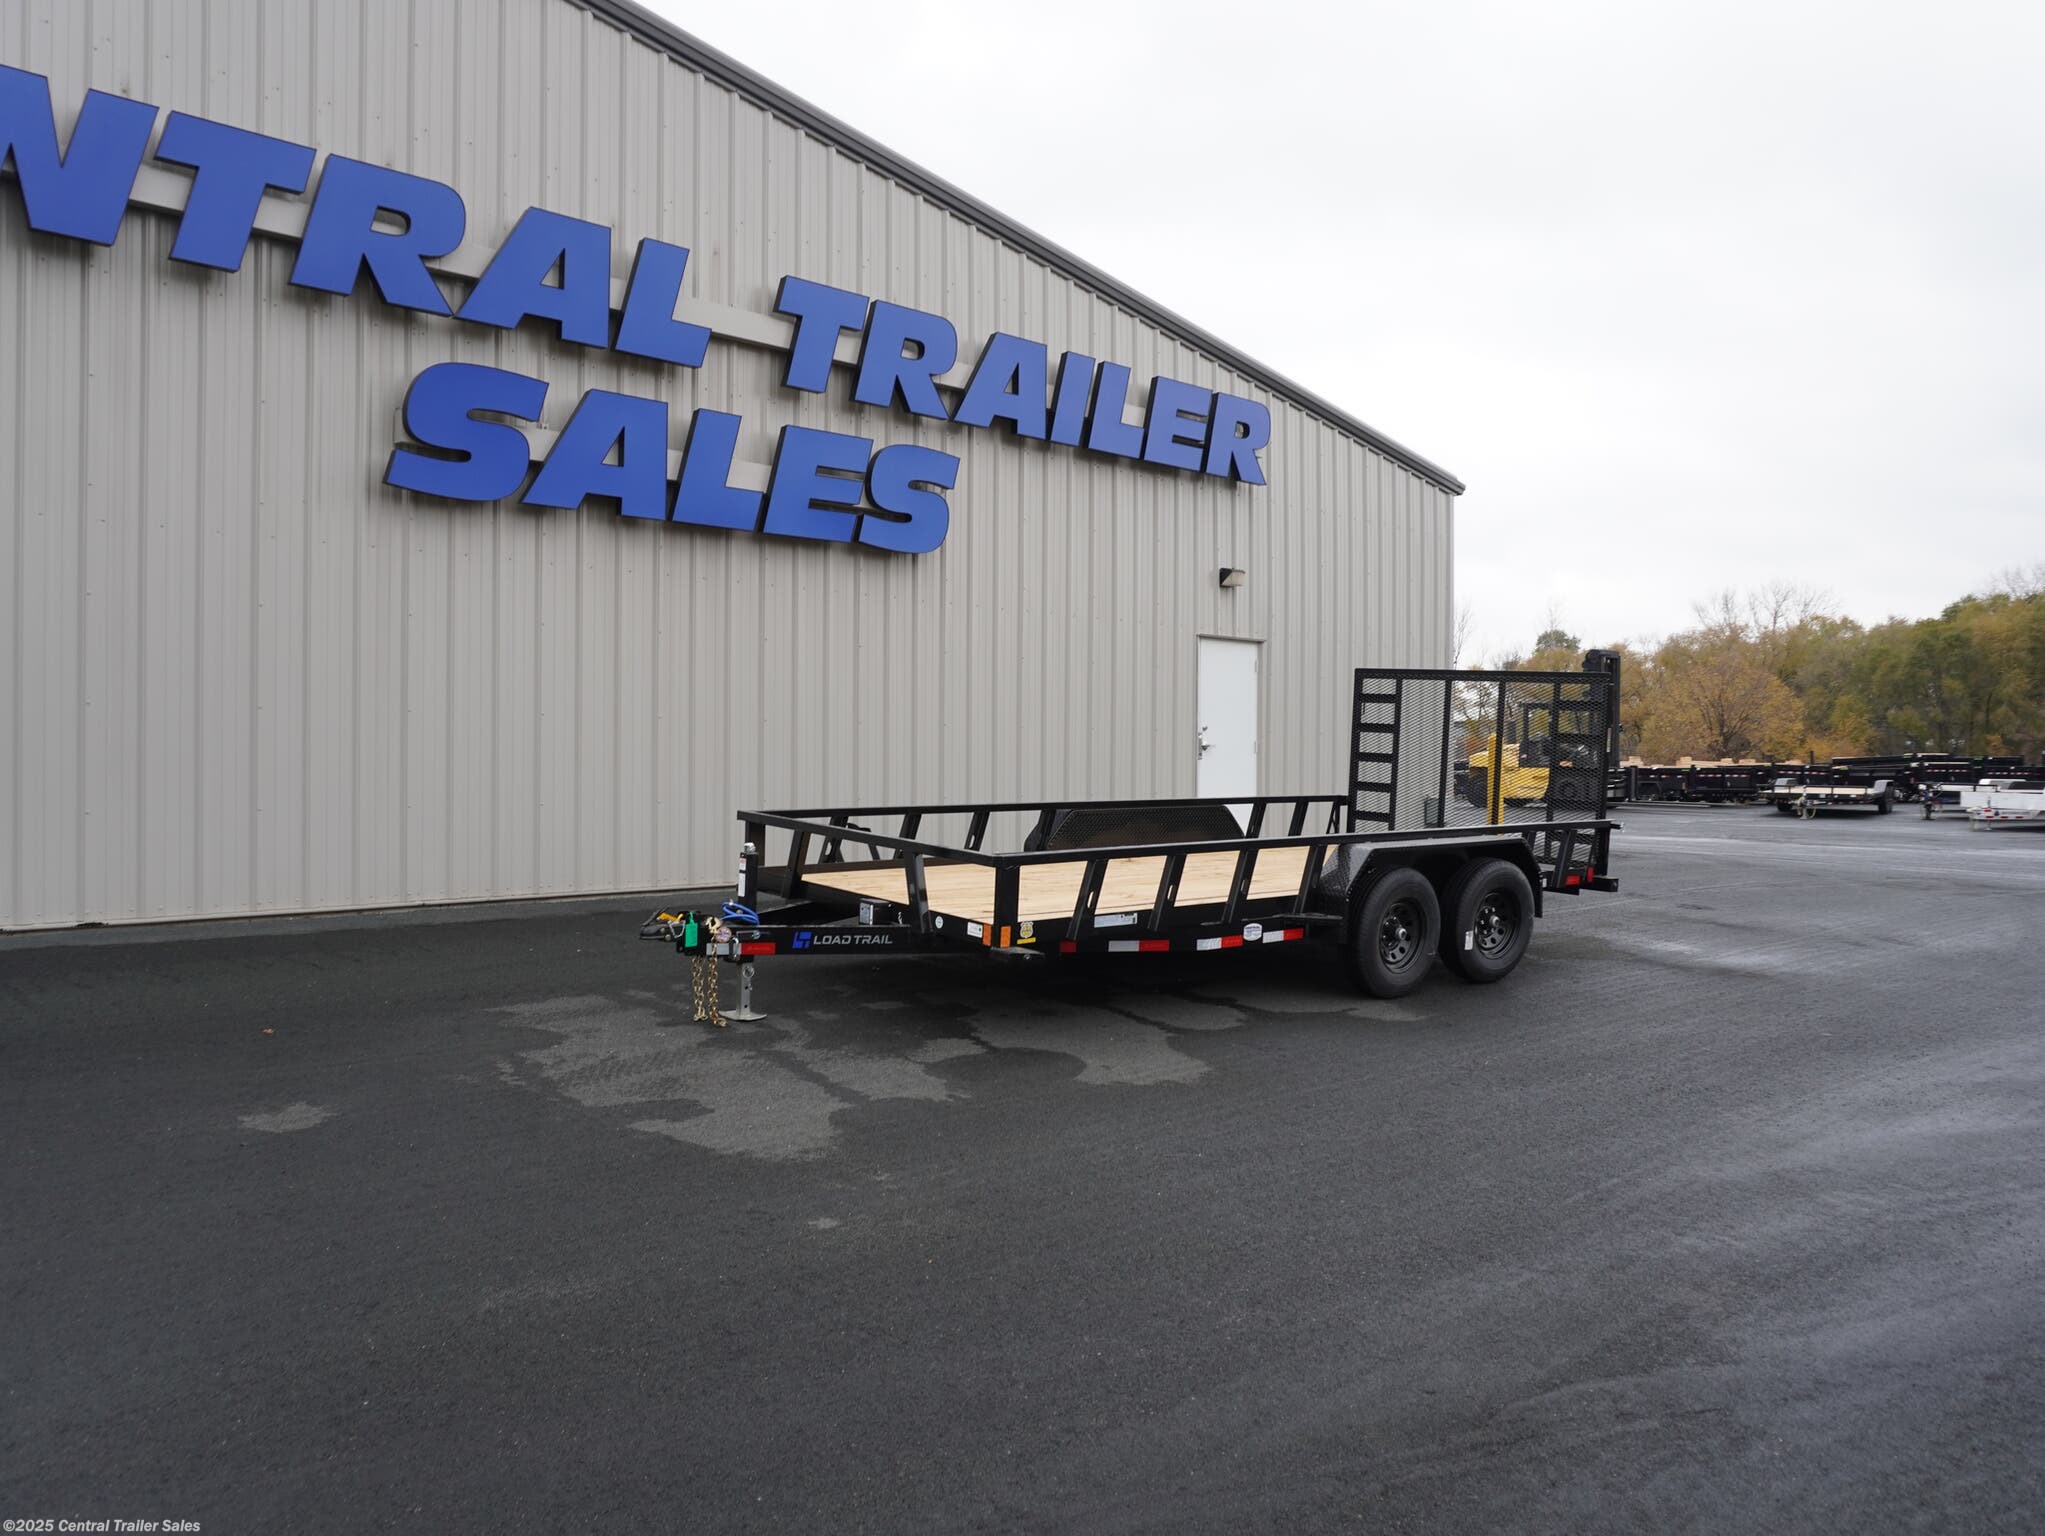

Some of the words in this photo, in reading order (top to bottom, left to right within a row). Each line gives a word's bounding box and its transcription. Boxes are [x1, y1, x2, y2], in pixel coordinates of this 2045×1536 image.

[382, 362, 960, 554] SALES
[773, 275, 1271, 486] TRAILER
[813, 935, 852, 945] LOAD
[854, 934, 893, 945] TRAIL
